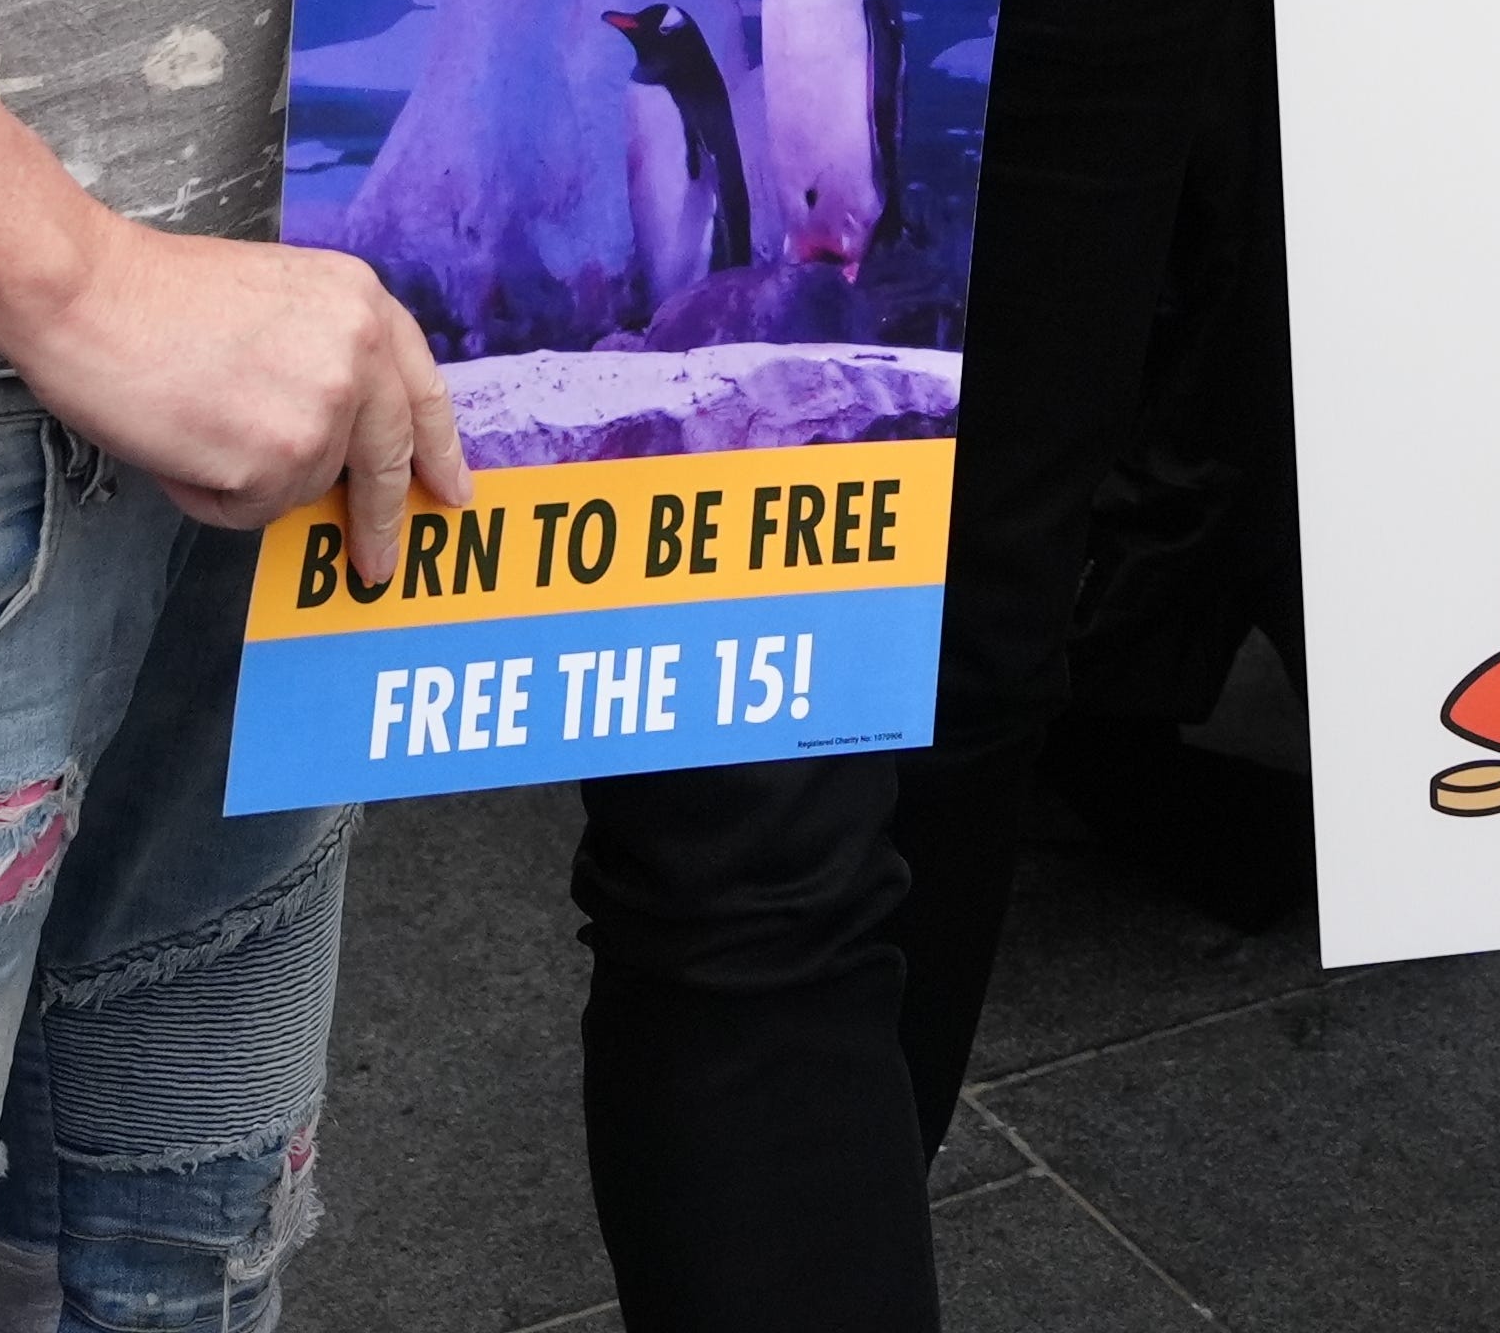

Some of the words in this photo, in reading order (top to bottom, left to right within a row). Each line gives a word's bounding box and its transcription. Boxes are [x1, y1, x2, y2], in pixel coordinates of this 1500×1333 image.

[533, 499, 618, 588] TO
[645, 490, 723, 579] BE
[748, 479, 900, 571] FREE
[369, 657, 534, 761] FREE
[558, 644, 681, 741] THE
[715, 633, 814, 726] 15!
